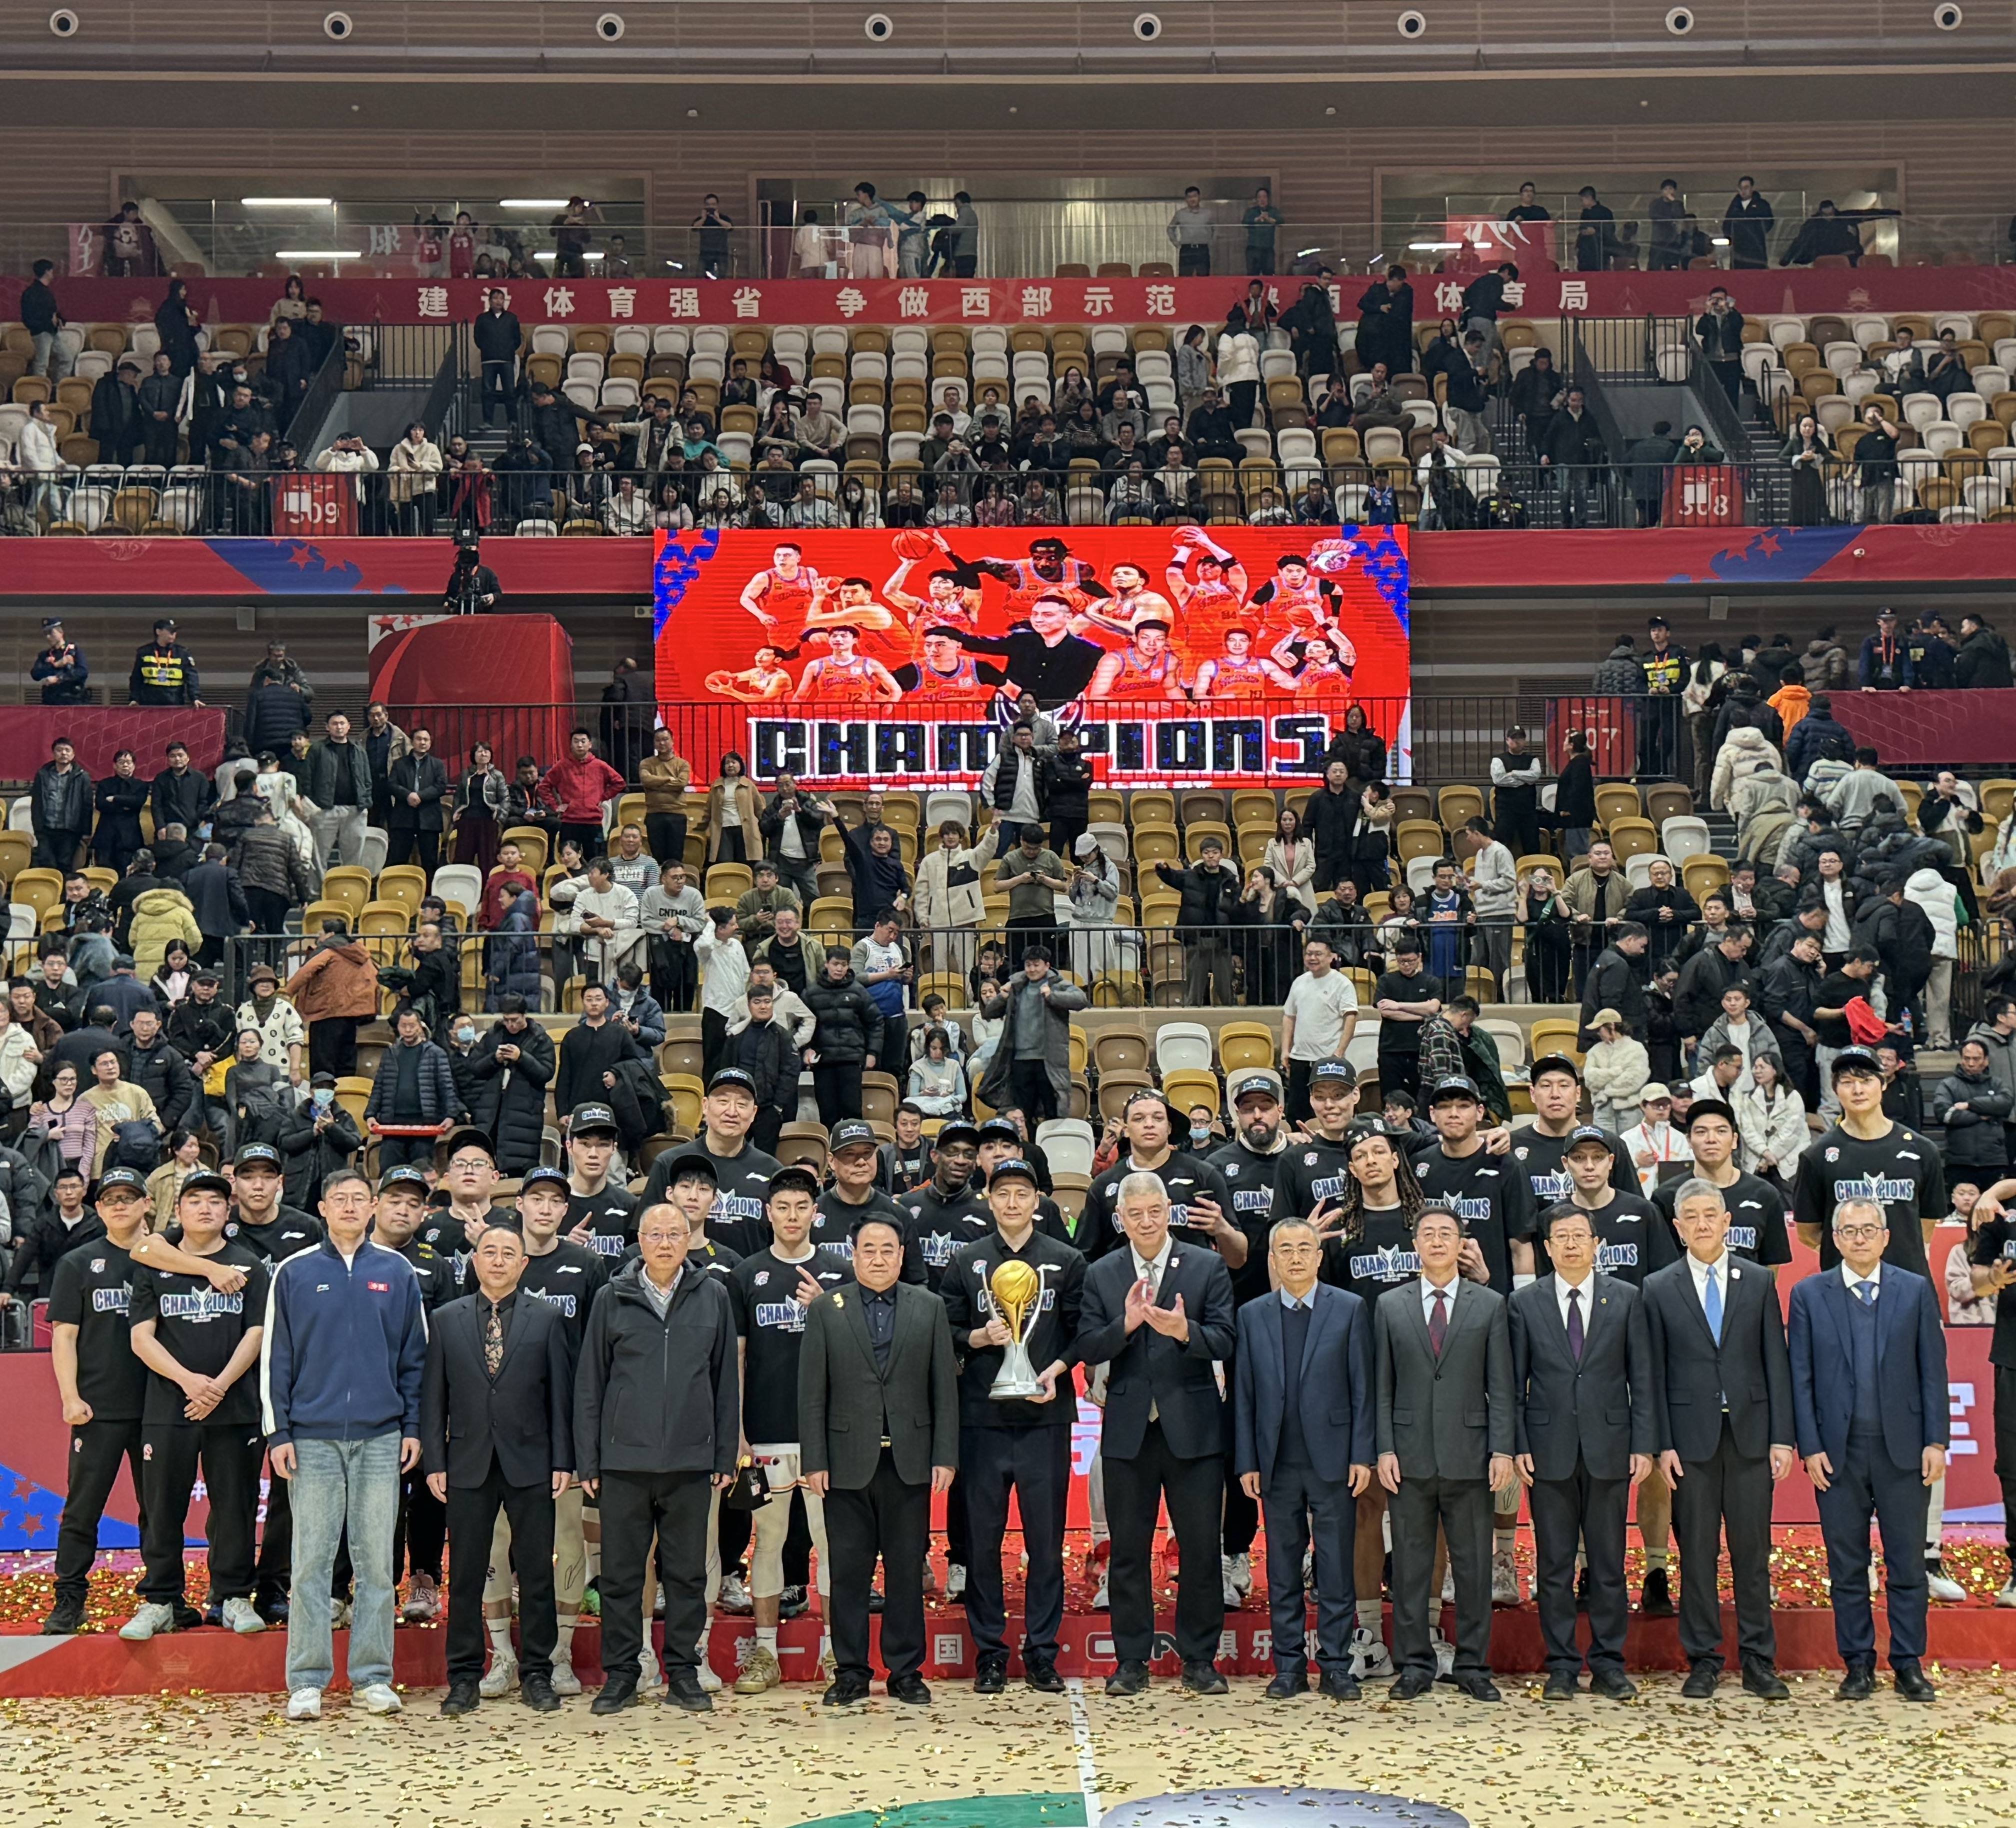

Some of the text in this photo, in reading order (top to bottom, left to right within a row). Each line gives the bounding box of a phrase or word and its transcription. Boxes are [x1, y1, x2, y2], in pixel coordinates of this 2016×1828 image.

[835, 284, 1176, 318] 争做西部示范
[1565, 728, 1618, 750] 07
[1834, 1178, 1915, 1202] CHAMPIONS
[1350, 1251, 1422, 1279] CHAMPION
[160, 1291, 244, 1317] CHAMPIONS
